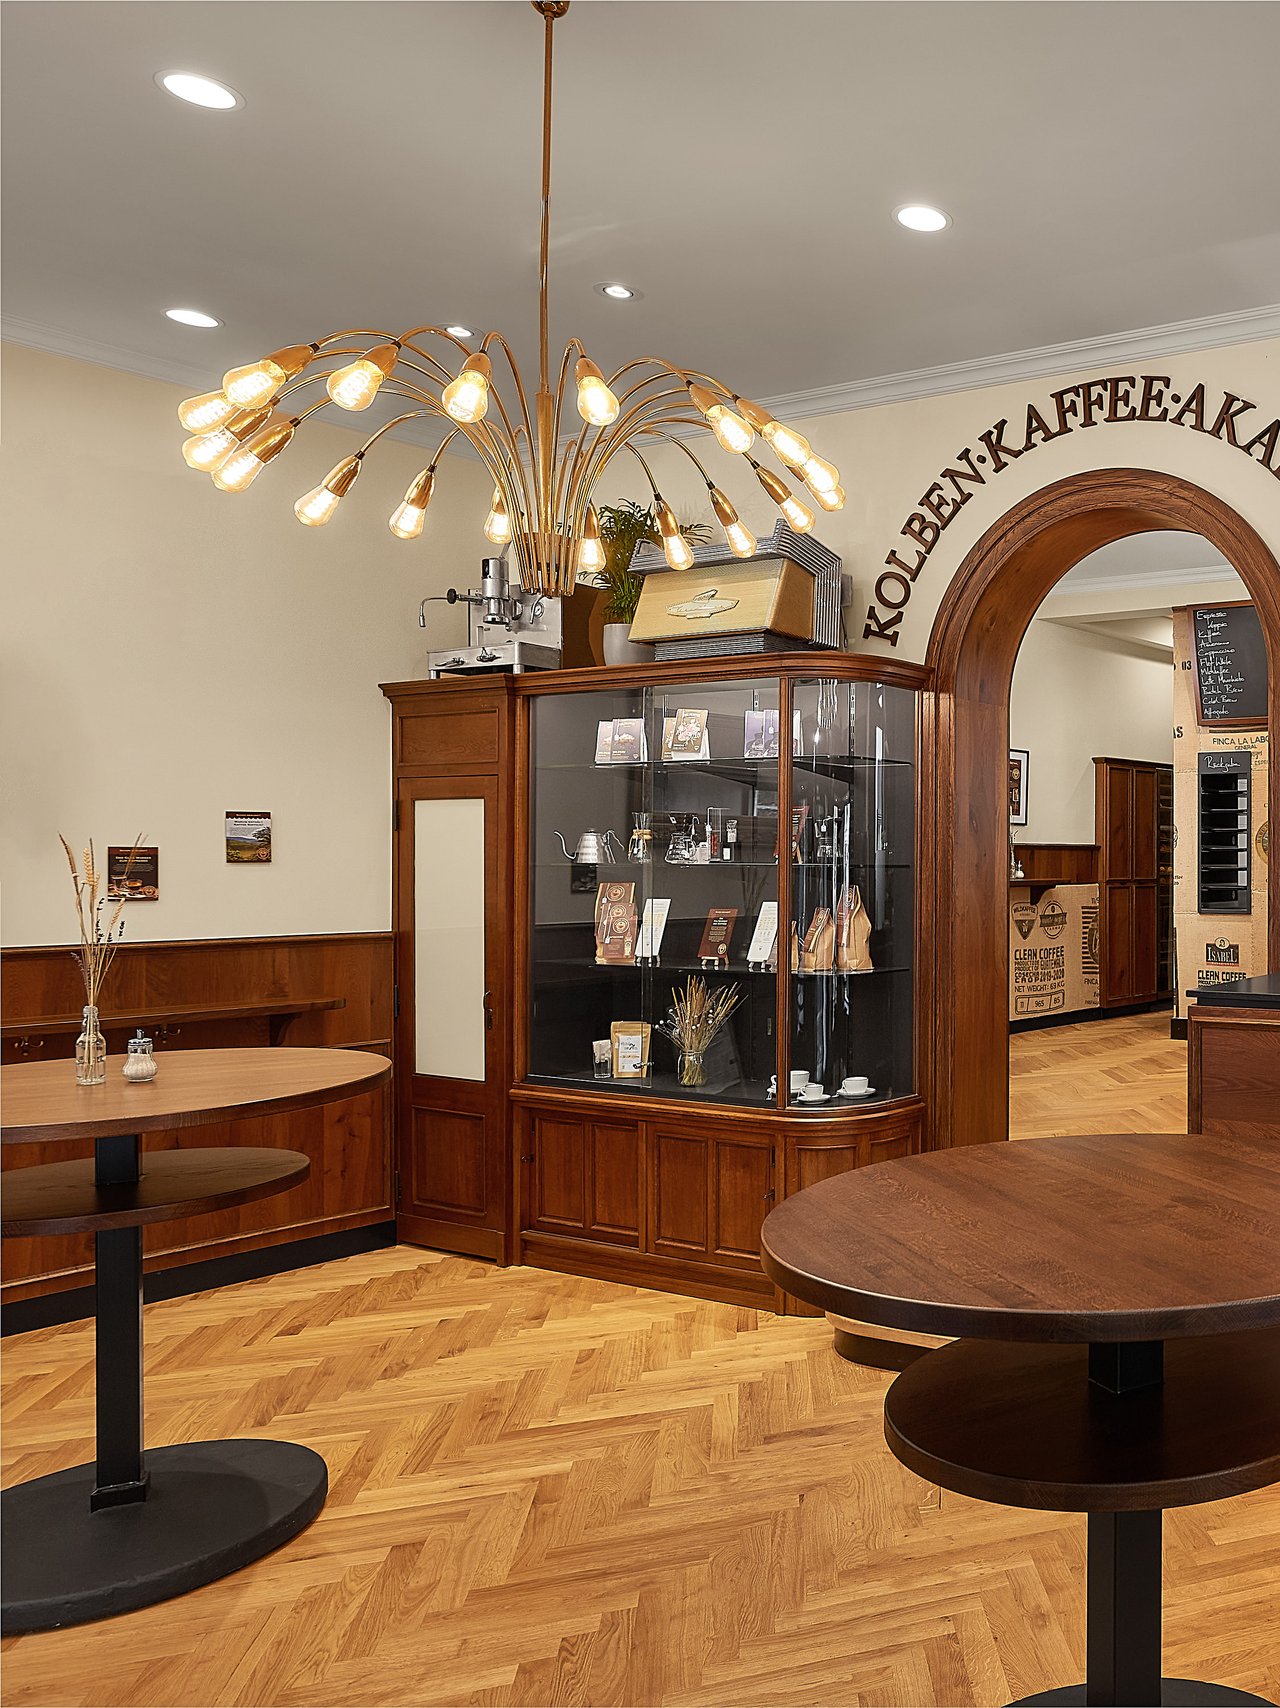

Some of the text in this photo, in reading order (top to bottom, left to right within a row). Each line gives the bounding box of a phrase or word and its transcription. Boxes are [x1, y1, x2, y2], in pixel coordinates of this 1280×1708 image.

[1212, 737, 1236, 745] FINCA
[1014, 945, 1065, 960] CLEAN COFFEE
[1197, 970, 1247, 982] CLEAN COFFEE
[1014, 985, 1025, 993] NET
[1027, 984, 1050, 992] WEIGHT:
[1057, 980, 1065, 988] KG
